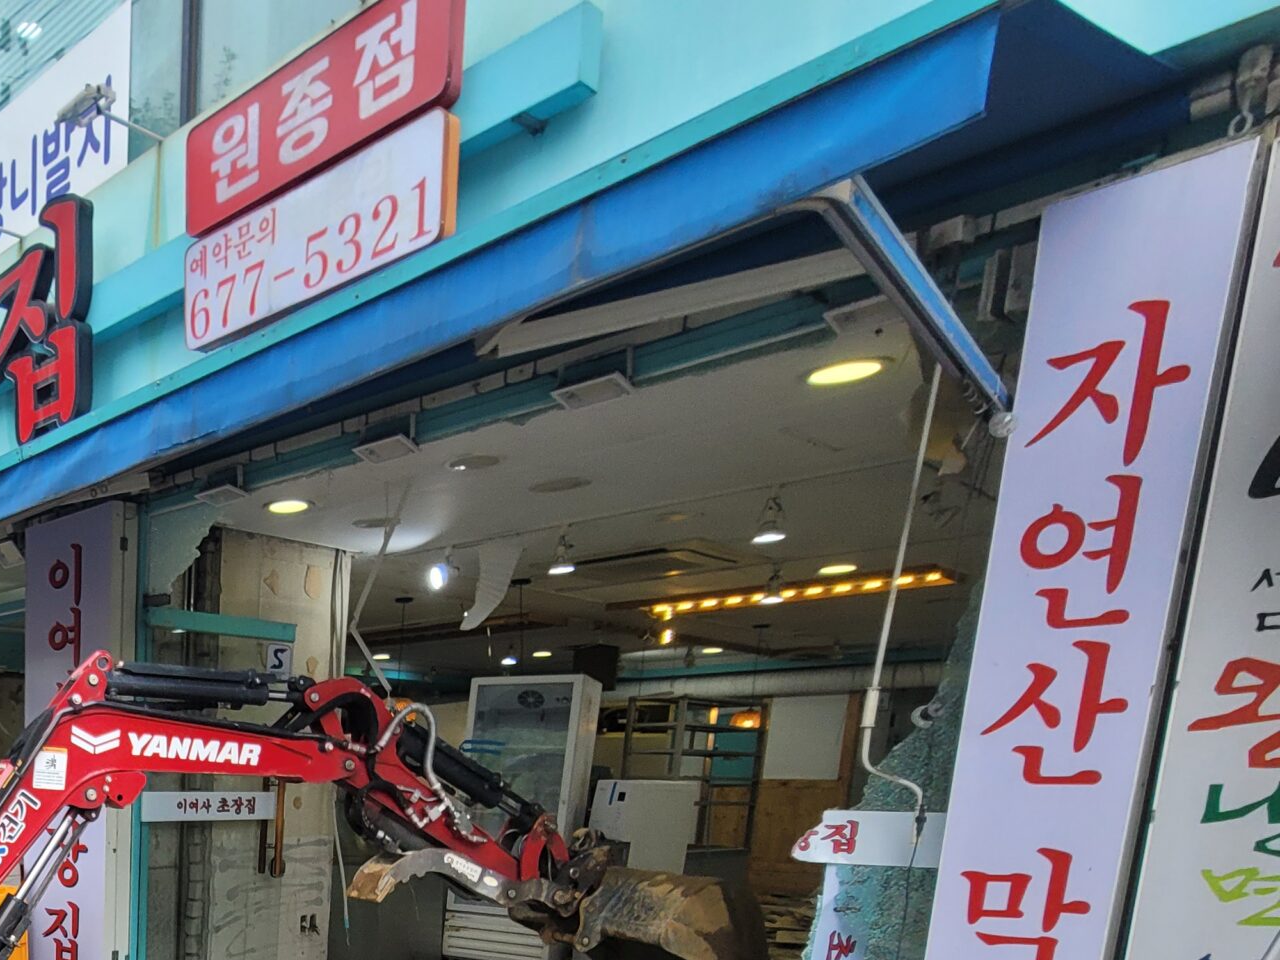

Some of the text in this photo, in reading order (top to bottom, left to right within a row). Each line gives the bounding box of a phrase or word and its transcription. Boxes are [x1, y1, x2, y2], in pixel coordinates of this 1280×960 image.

[209, 3, 417, 204] 원종점
[189, 207, 277, 280] 예약문의
[190, 177, 433, 342] 677-5321
[981, 300, 1191, 786] 자연산
[128, 731, 262, 767] YANMAR
[177, 796, 256, 815] 이여사 초장집
